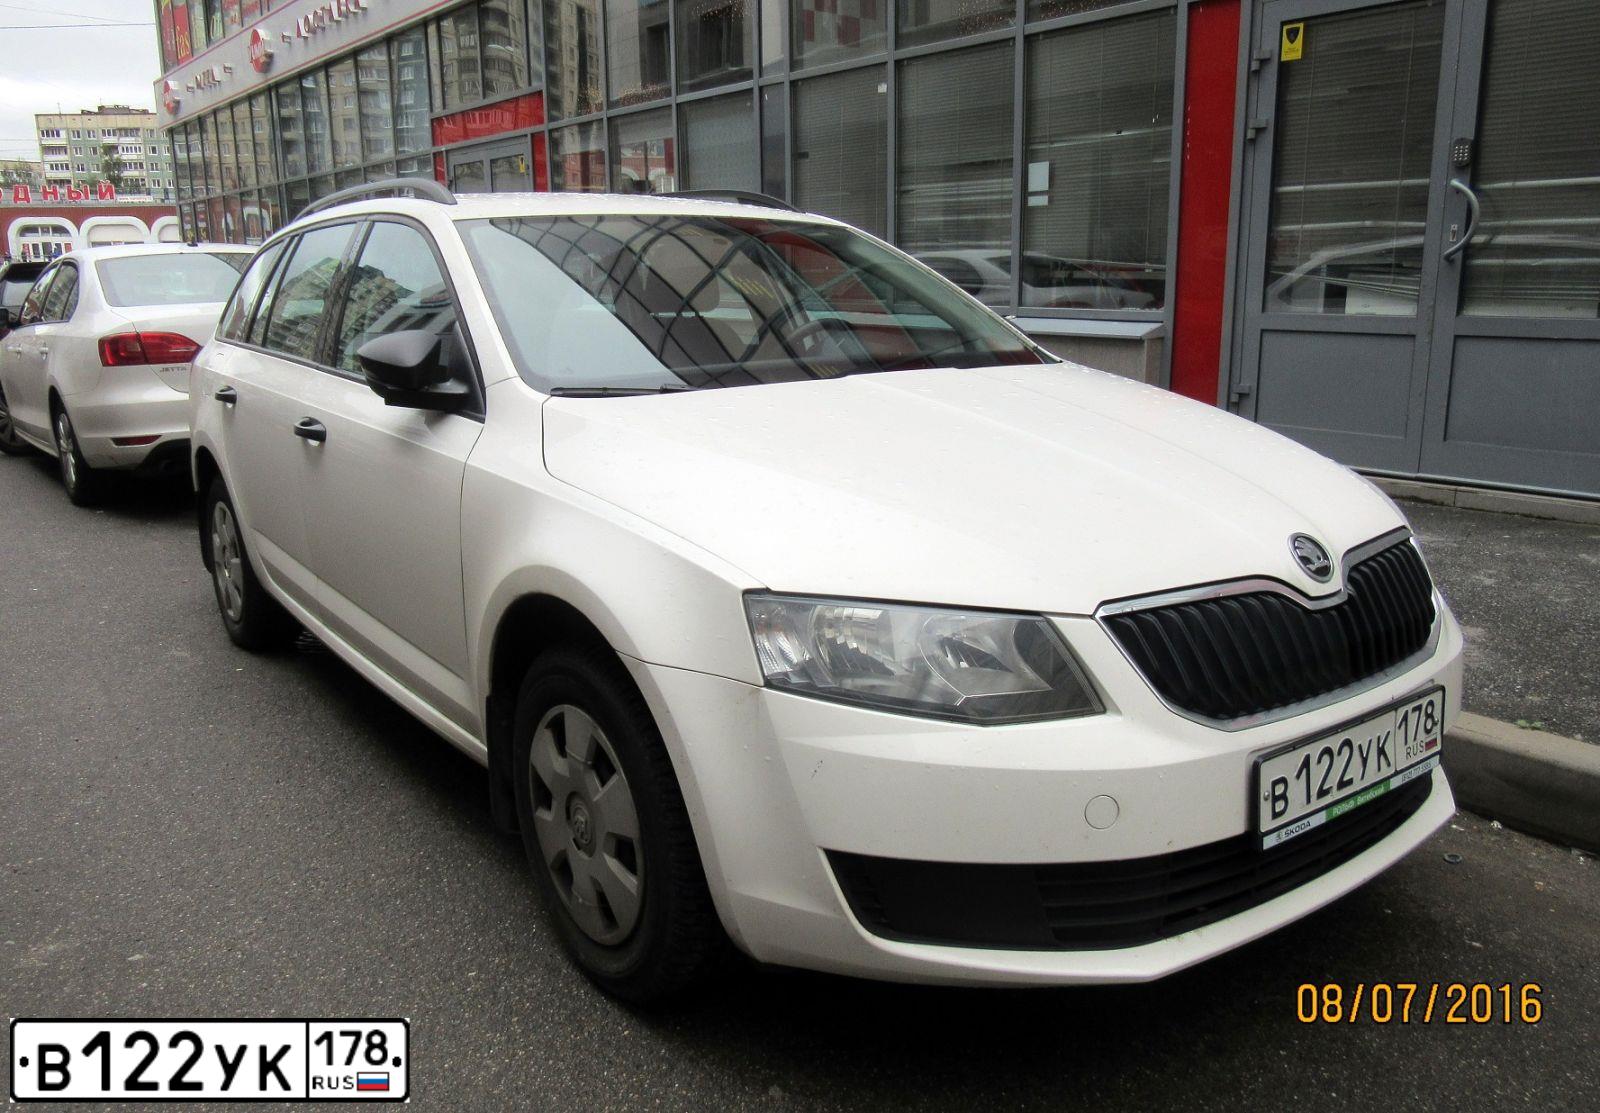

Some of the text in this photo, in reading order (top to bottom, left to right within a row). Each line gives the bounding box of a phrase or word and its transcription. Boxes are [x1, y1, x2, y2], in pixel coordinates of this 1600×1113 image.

[0, 180, 116, 203] ДНЫЙ
[1397, 699, 1436, 746] 178
[1405, 740, 1425, 760] RUS
